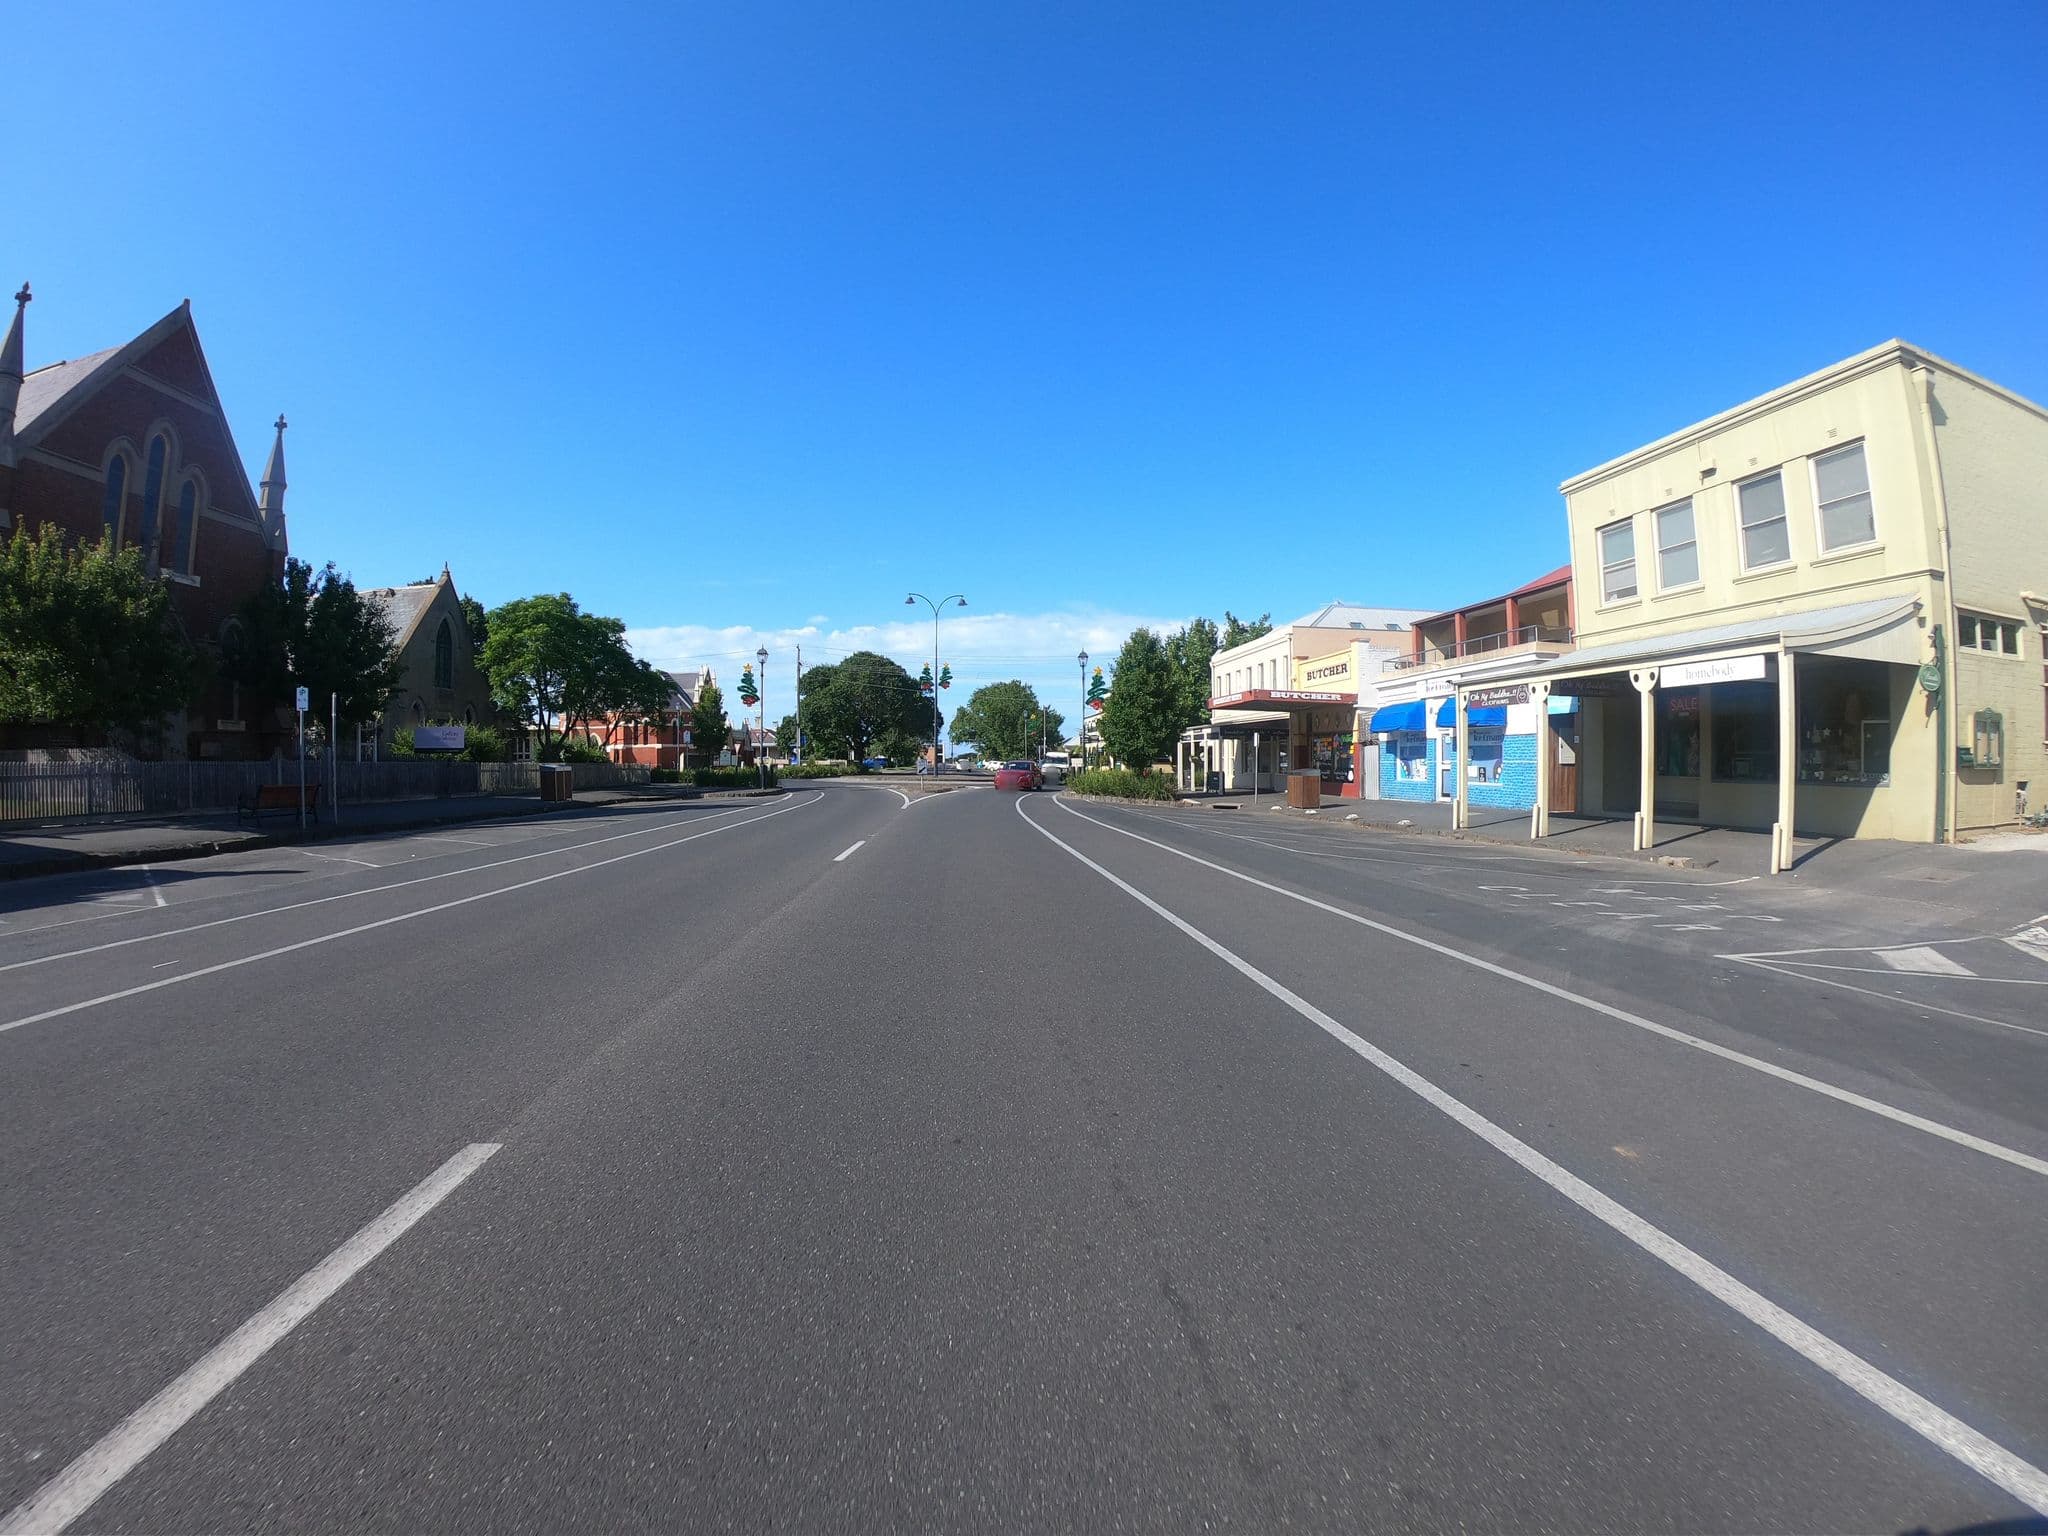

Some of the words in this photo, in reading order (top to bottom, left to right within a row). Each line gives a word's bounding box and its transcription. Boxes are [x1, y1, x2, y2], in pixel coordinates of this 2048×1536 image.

[1306, 663, 1348, 681] BUTCHER
[1685, 663, 1736, 681] homebody
[1270, 691, 1342, 701] BUTCHER
[1670, 697, 1697, 711] SALE
